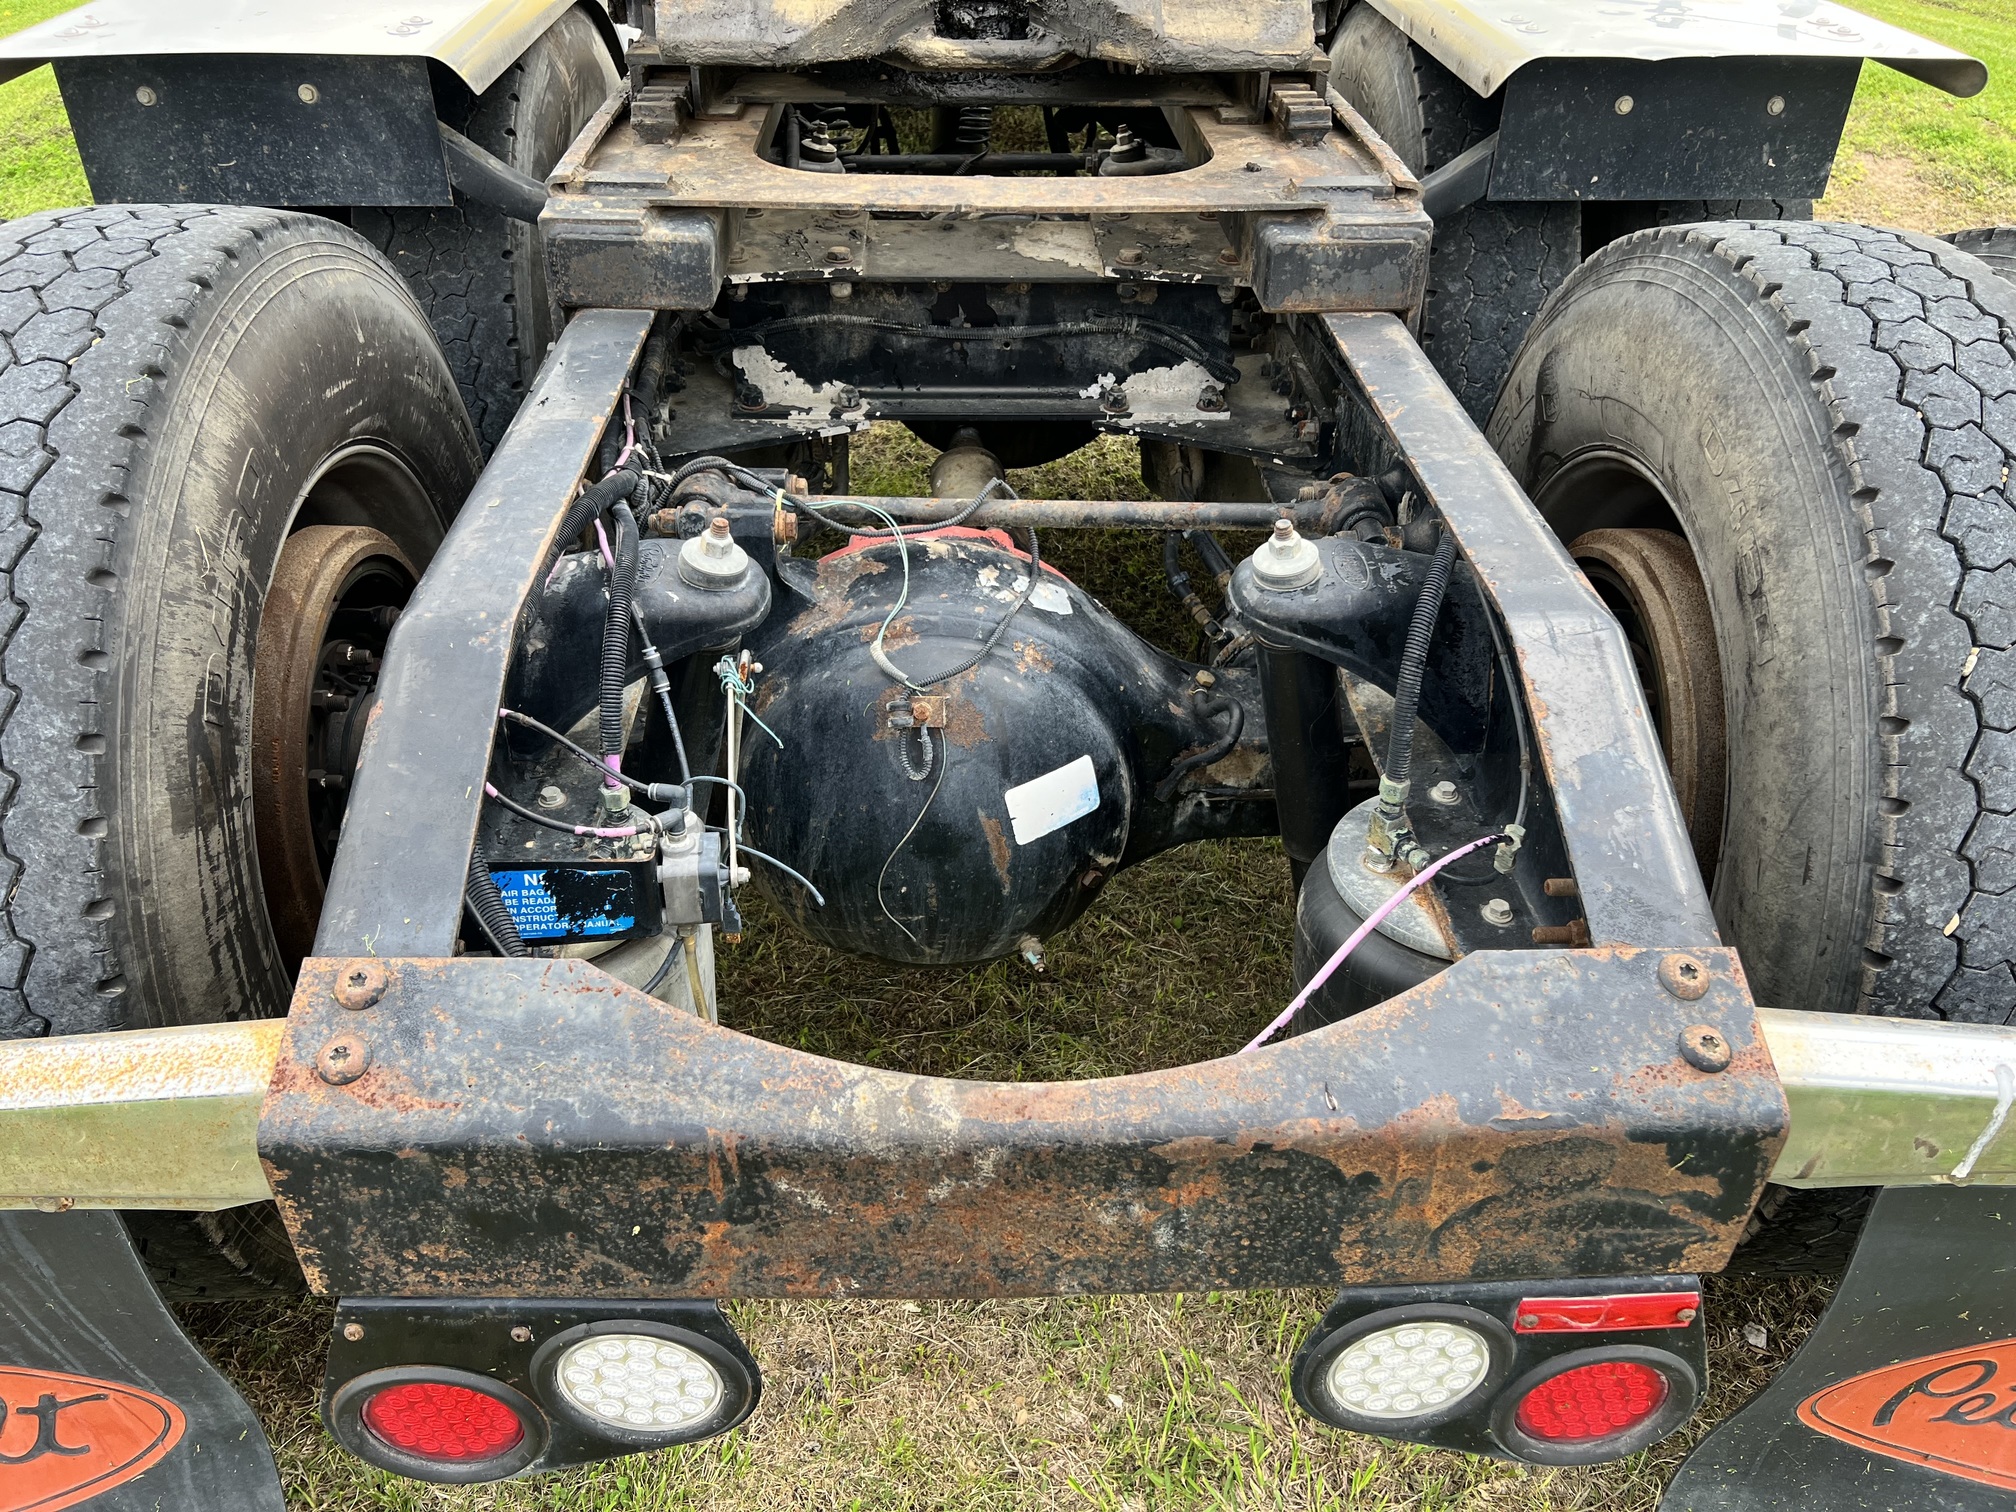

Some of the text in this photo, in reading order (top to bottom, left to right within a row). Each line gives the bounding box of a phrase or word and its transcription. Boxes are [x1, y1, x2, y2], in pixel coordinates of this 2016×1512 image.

[501, 888, 545, 898] AIR BAG
[504, 898, 519, 906] BE
[511, 914, 559, 923] NSTRUC
[1873, 1359, 2016, 1430] Pe
